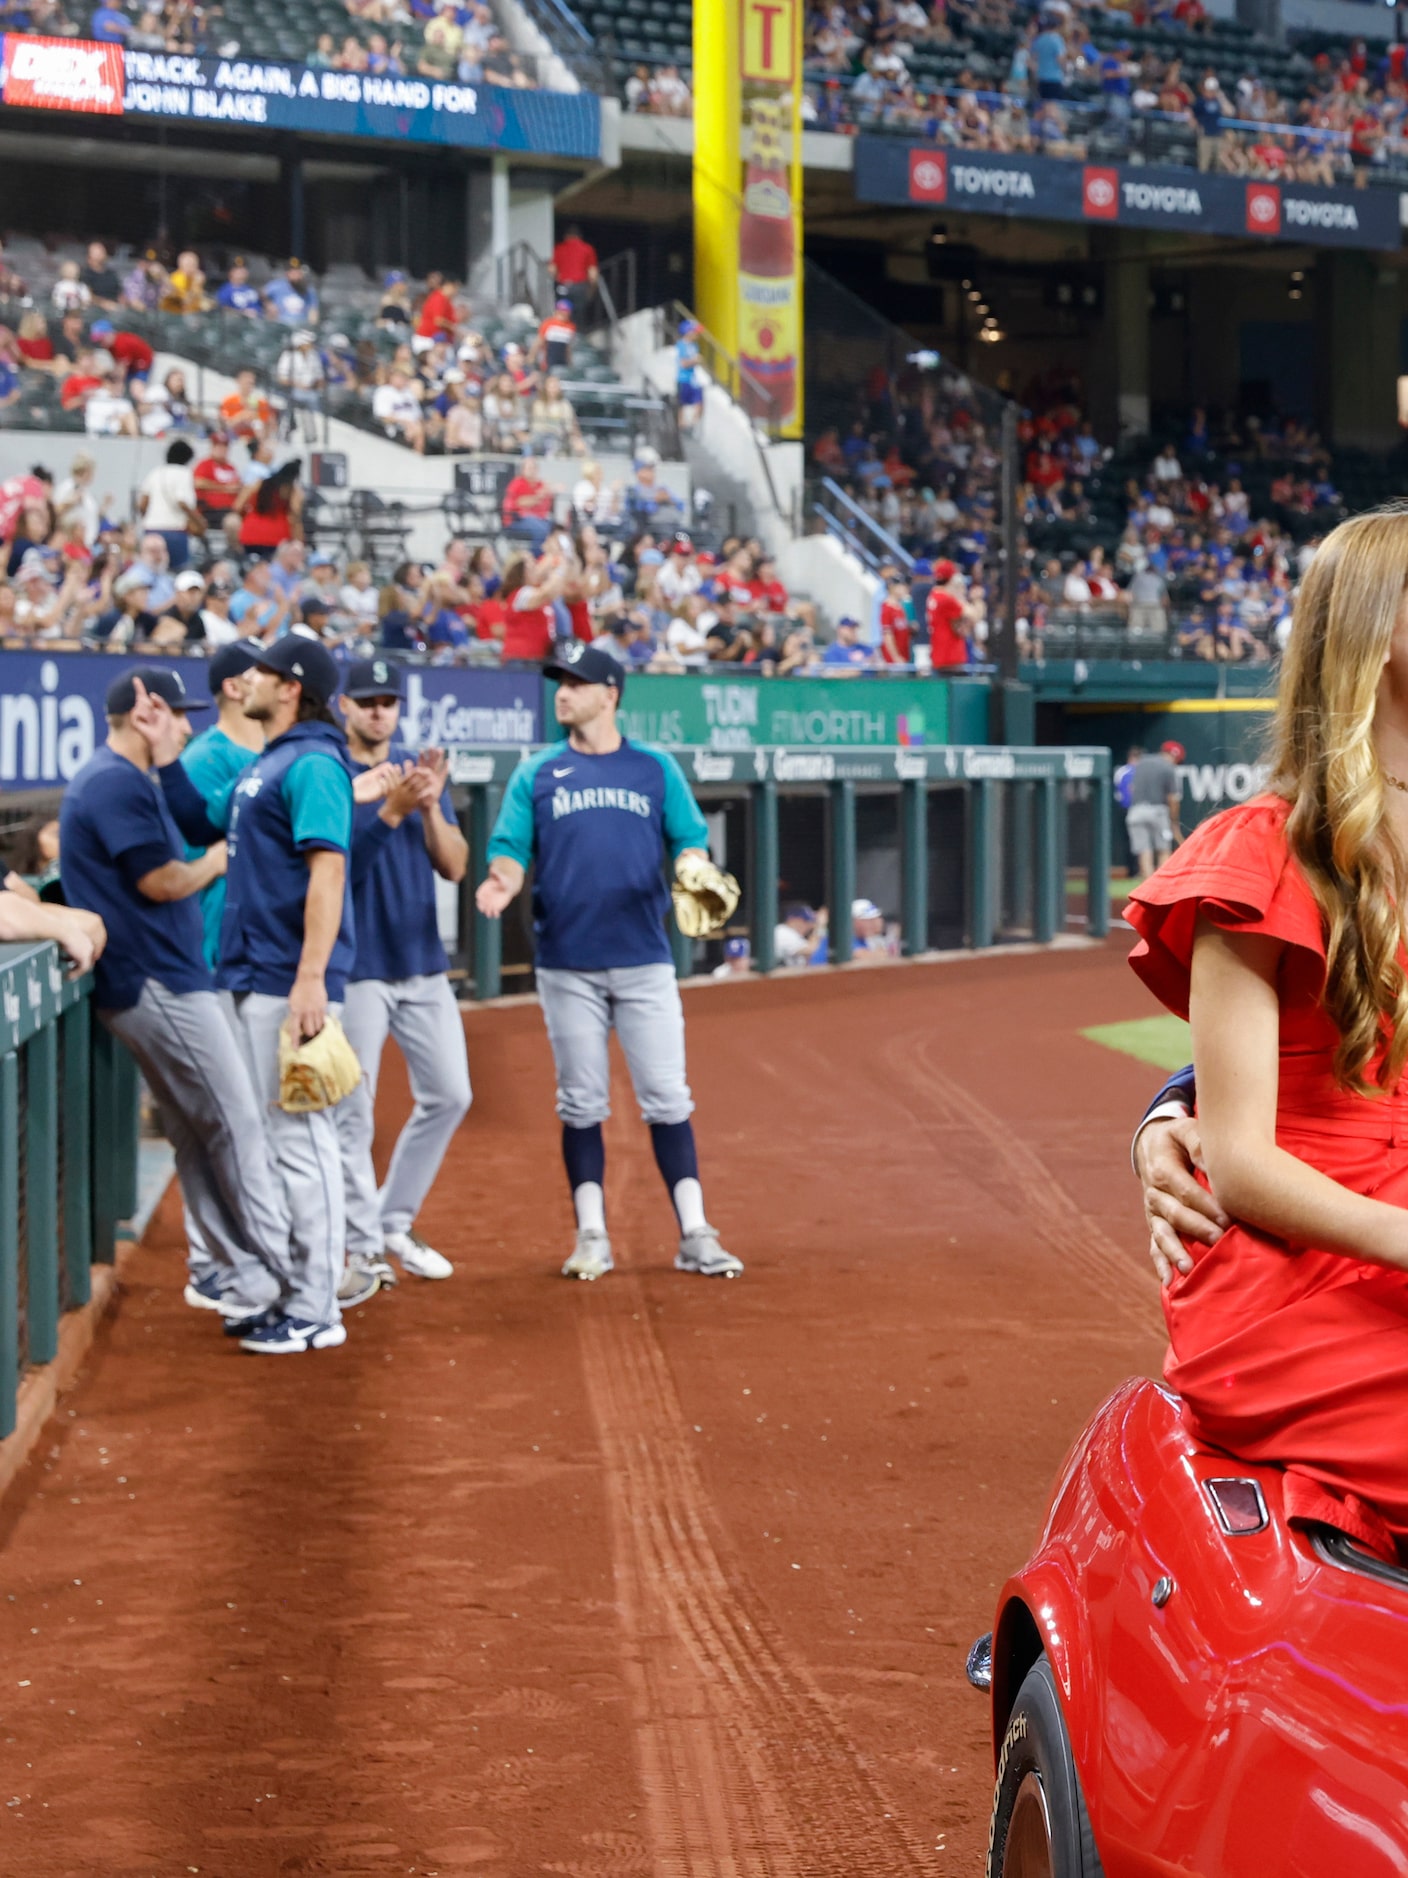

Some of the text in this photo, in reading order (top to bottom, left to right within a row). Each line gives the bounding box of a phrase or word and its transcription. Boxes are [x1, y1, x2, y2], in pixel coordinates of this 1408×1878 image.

[752, 4, 784, 70] T
[123, 81, 190, 115] JOHN
[191, 88, 267, 123] BLAKE
[214, 60, 297, 99] AGAIN,
[298, 70, 320, 98] A
[321, 71, 361, 103] BIG
[362, 76, 431, 110] HAND
[431, 83, 478, 115] FOR
[952, 165, 1035, 199] TOYOTA
[1122, 182, 1201, 215] TOYOTA
[1284, 198, 1358, 230] TOYOTA
[373, 660, 388, 684] S
[434, 694, 536, 744] Germania
[551, 786, 651, 820] MARINERS
